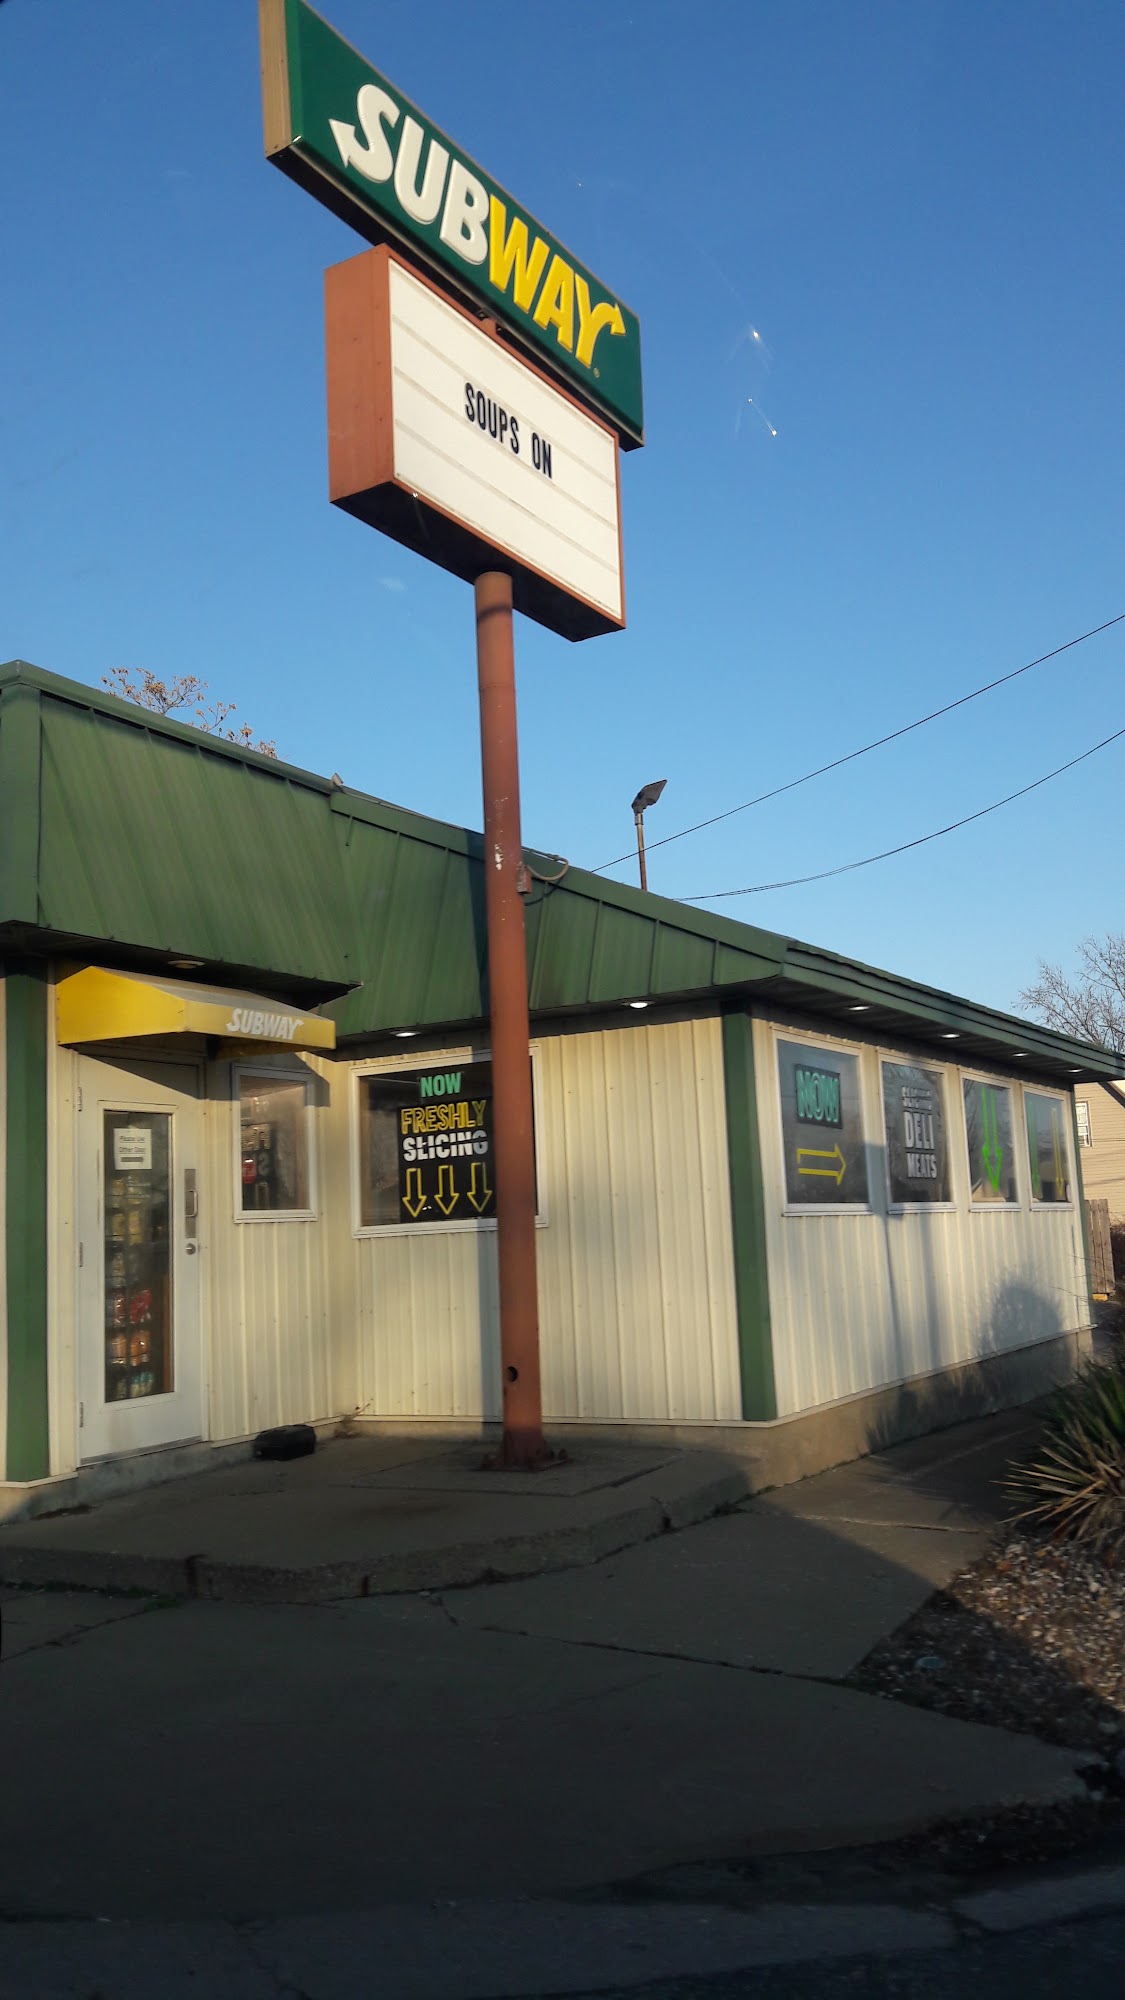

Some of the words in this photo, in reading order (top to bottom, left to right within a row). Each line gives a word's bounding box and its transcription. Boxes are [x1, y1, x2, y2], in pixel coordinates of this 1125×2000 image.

[328, 83, 627, 369] SUBWAY
[464, 382, 520, 455] SOUPS
[532, 432, 553, 479] ON
[225, 1007, 304, 1041] SUBWAY
[419, 1072, 463, 1098] NOW
[796, 1069, 839, 1123] NOW
[400, 1099, 487, 1135] FRESHLY
[903, 1111, 935, 1150] DELI
[402, 1129, 489, 1162] SLICING
[907, 1153, 938, 1179] MEATS
